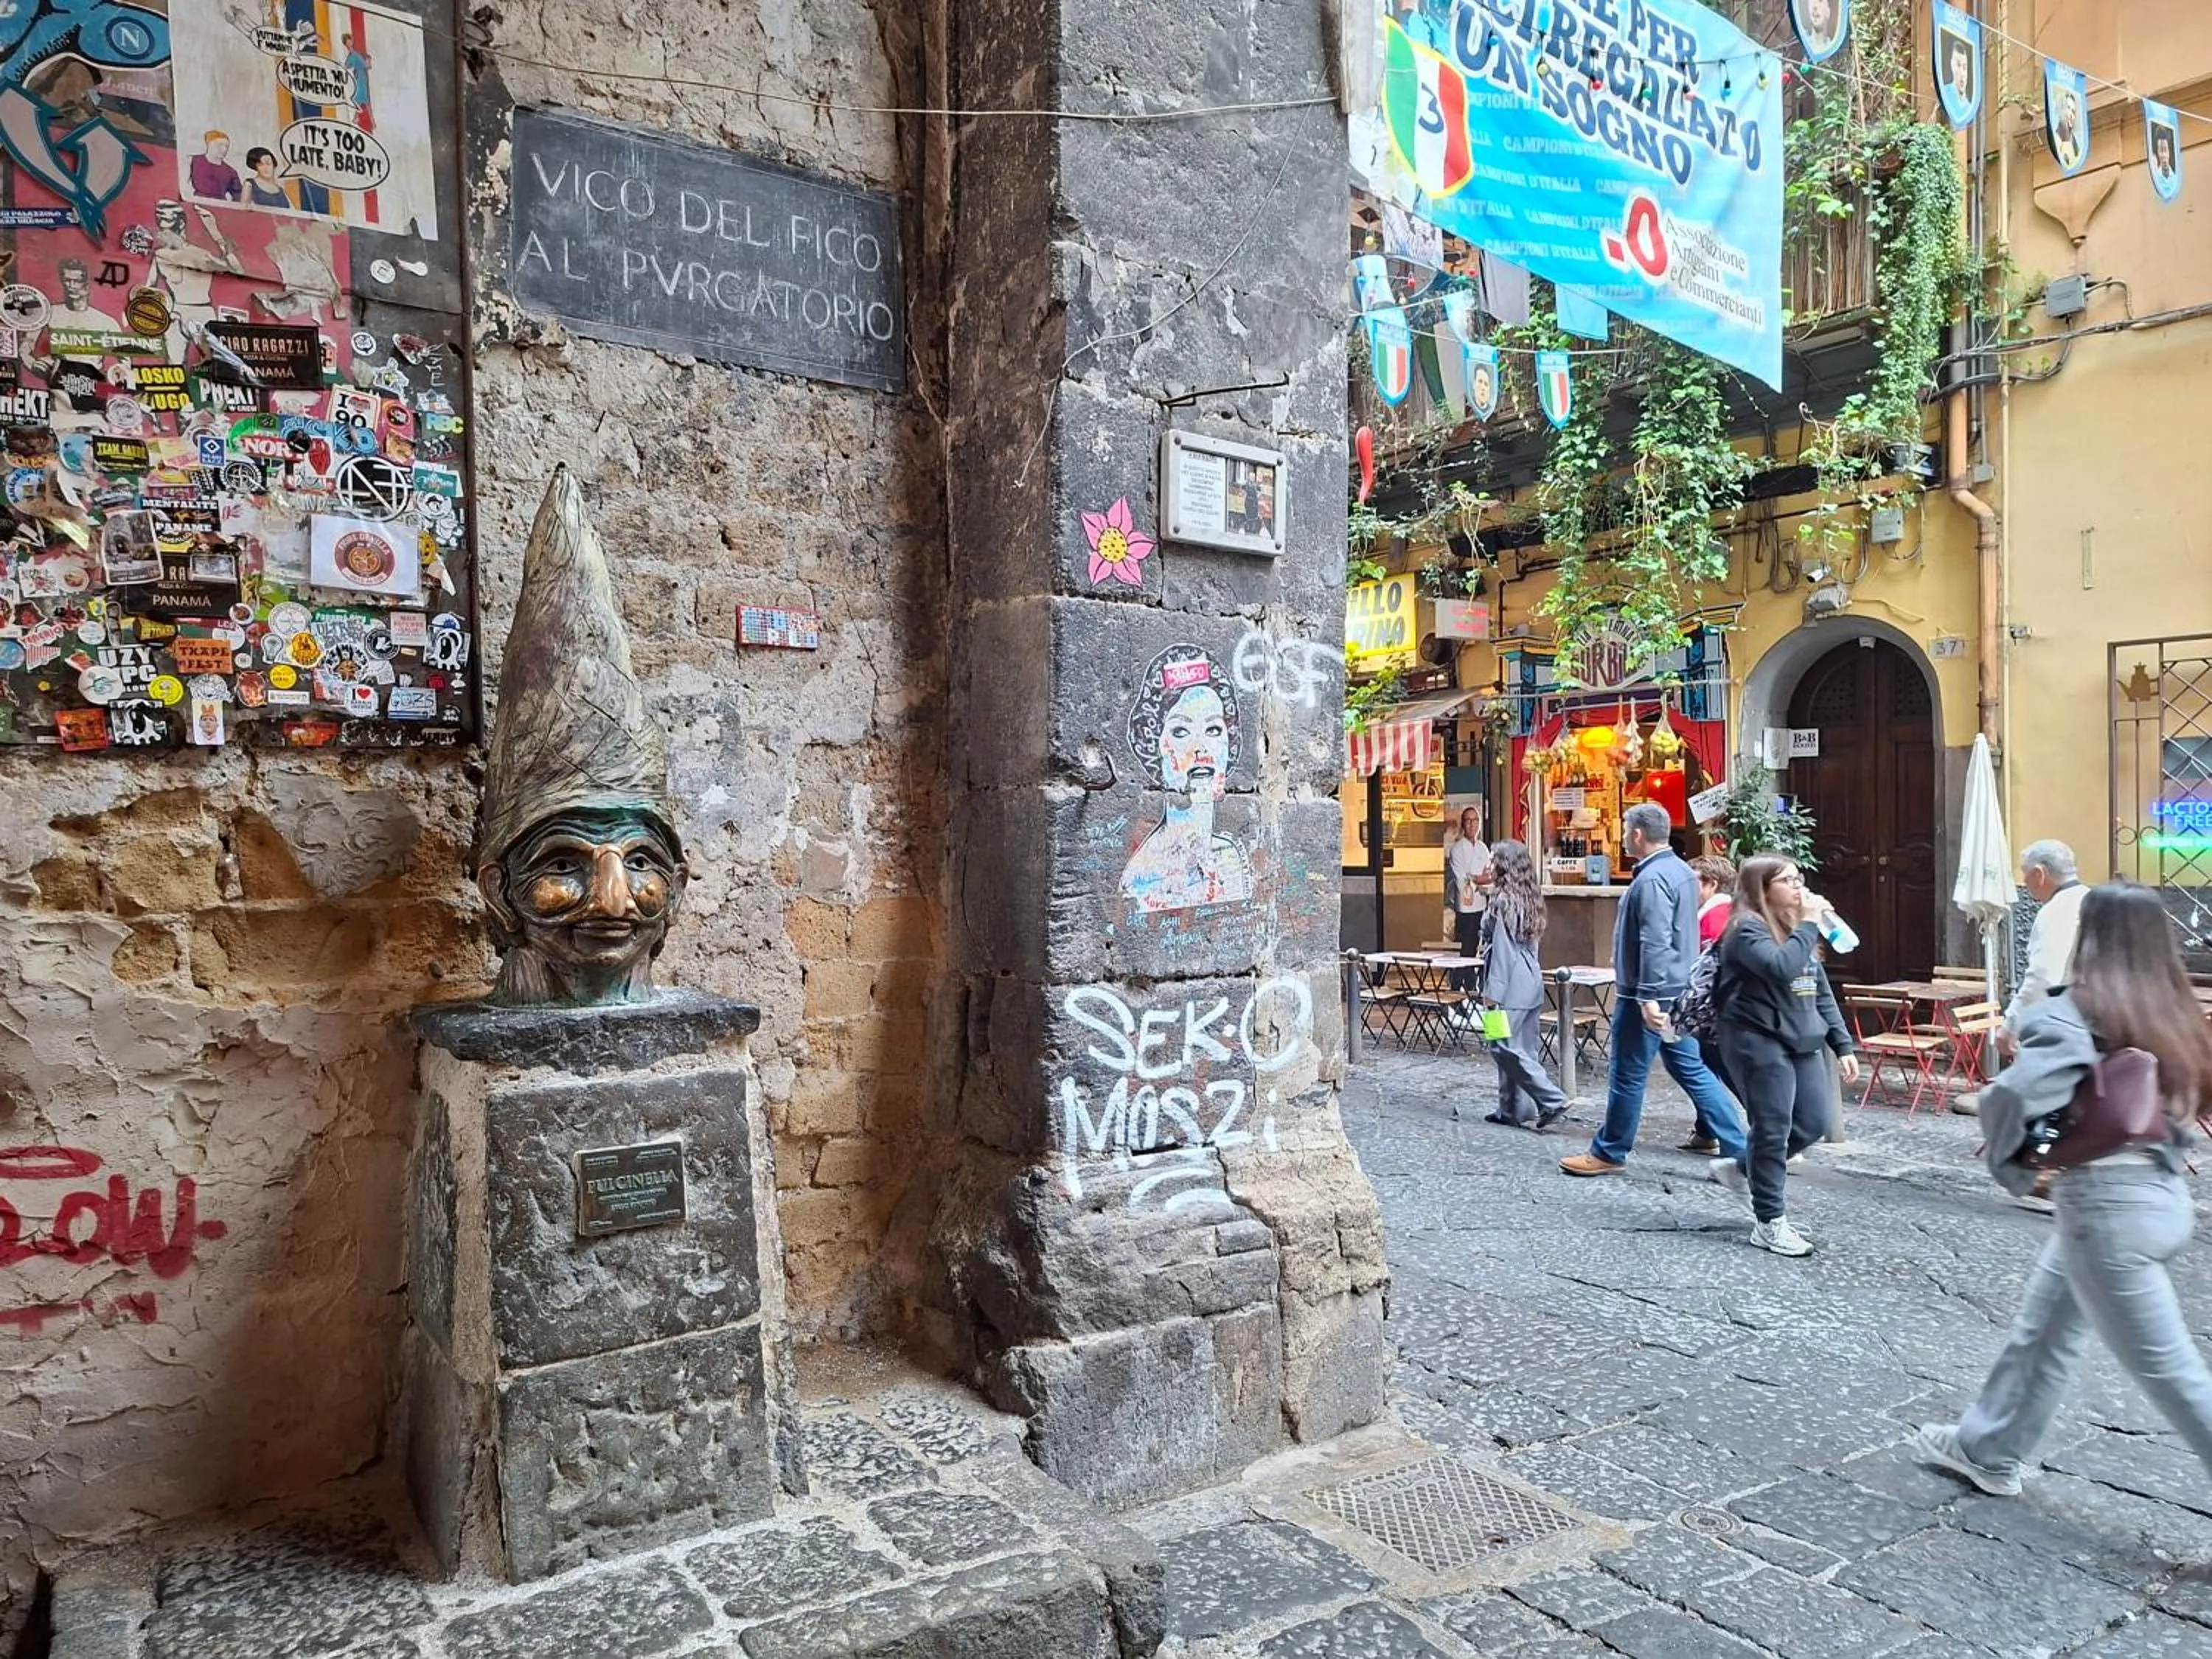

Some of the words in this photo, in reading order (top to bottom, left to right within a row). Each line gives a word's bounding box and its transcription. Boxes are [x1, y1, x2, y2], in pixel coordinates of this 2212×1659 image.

[119, 27, 141, 49] N
[1627, 0, 1700, 83] PER
[282, 60, 327, 81] ASPETTA
[1455, 4, 1529, 94] UN
[1538, 68, 1691, 184] SOGNO
[1545, 2, 1762, 170] REGALATO
[1418, 82, 1444, 133] 3
[304, 125, 329, 147] IT'S
[334, 130, 365, 153] TOO
[333, 151, 381, 178] BABY!
[531, 153, 656, 218] VICO
[680, 190, 771, 247] DEL
[790, 215, 882, 273] FICO
[1666, 217, 1745, 272] Associazione
[517, 230, 589, 282] AL
[622, 247, 894, 341] PVRGATORIO
[1670, 265, 1677, 281] e
[1678, 268, 1762, 325] Commercianti
[50, 333, 163, 351] SAINT-ÉTIENNE
[220, 335, 248, 352] CIAO
[253, 338, 309, 355] RAGAZZI
[338, 393, 347, 408] I
[335, 409, 366, 428] 90
[155, 523, 213, 533] PANAME
[2152, 801, 2212, 815] LACTO
[2174, 815, 2212, 827] FREE
[586, 1169, 679, 1194] PULCINELLA
